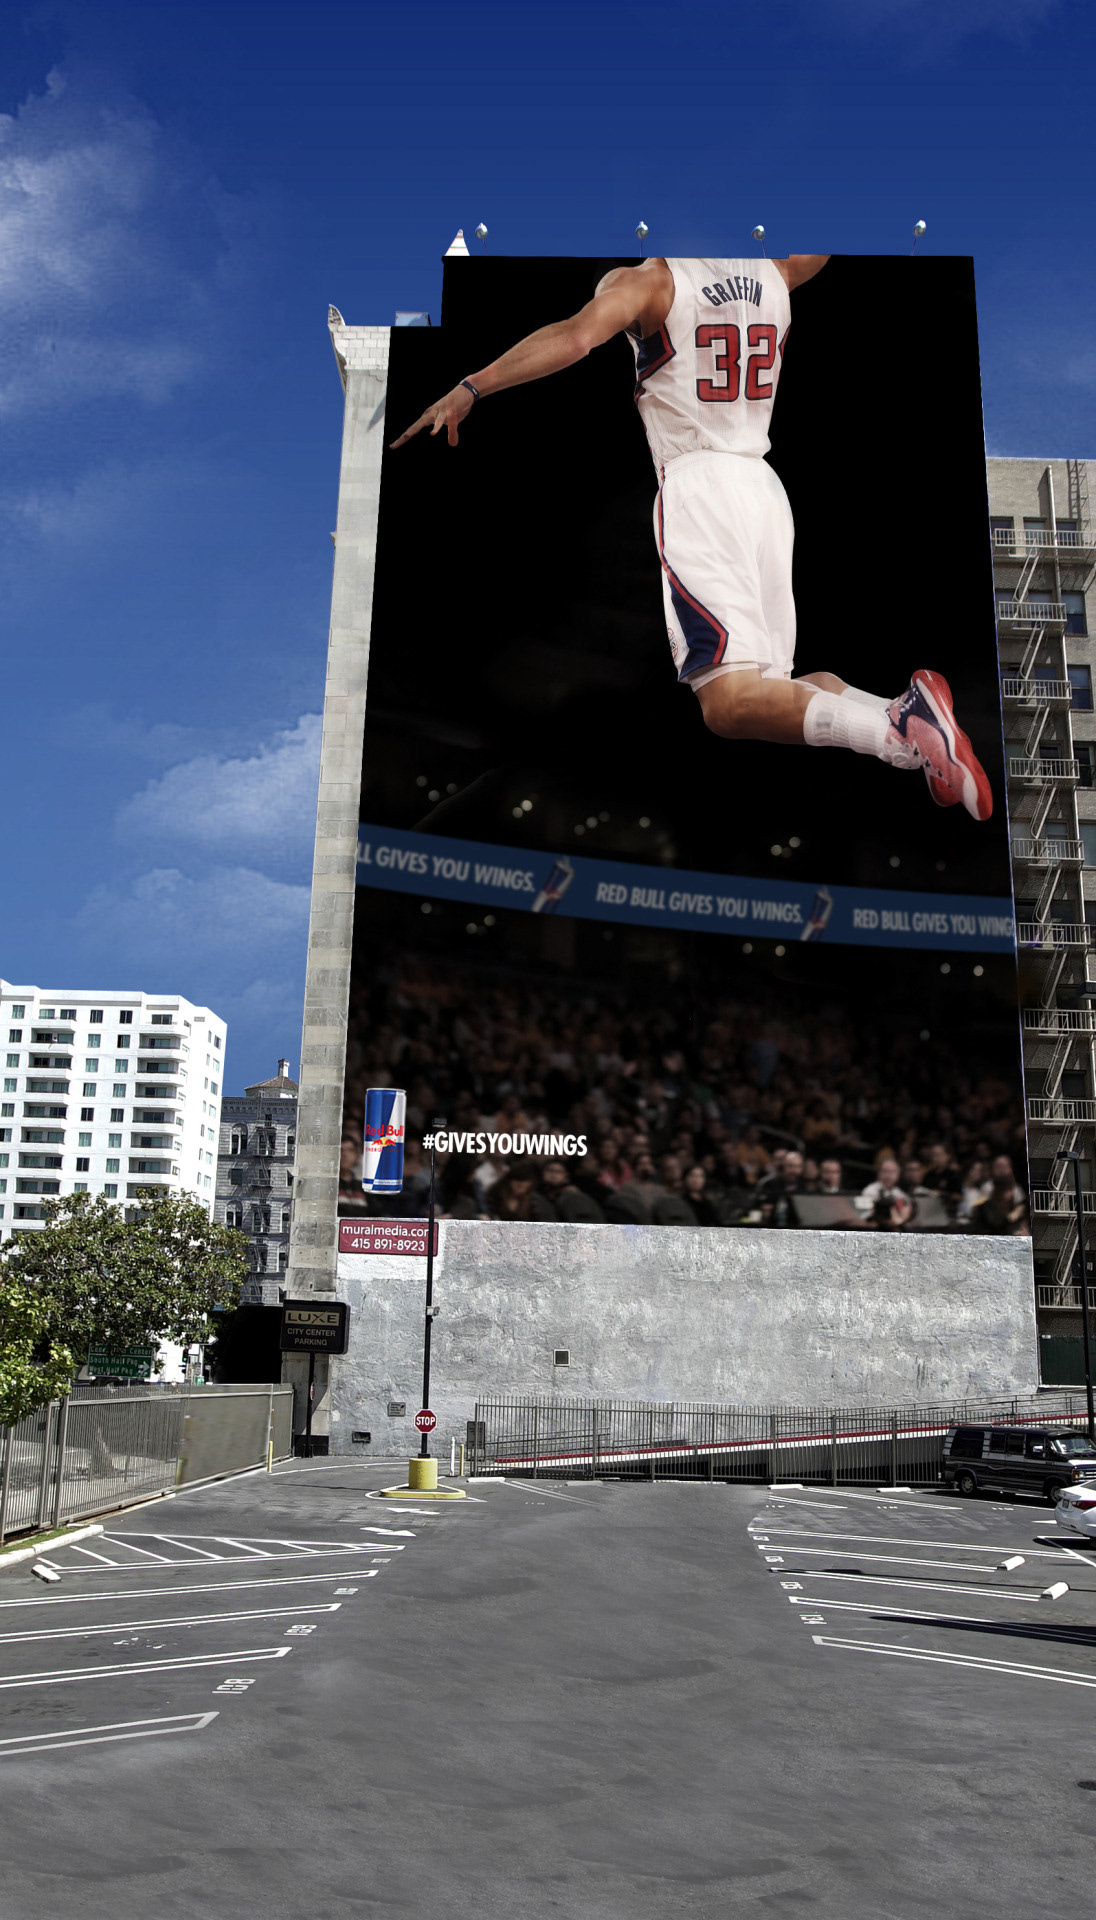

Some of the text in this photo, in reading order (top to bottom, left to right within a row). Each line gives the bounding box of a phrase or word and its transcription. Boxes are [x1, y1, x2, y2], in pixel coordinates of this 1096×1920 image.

[702, 276, 762, 307] GRIFFIN
[695, 324, 777, 402] 32
[375, 846, 428, 874] GIVES
[432, 856, 470, 881] YOU
[474, 863, 536, 892] WINGS.
[596, 881, 804, 923] RED BULL GIVES YOU WINGS.
[853, 908, 1015, 937] RED BULL GIVES YOU WING
[366, 1124, 404, 1137] Red Bull
[422, 1131, 588, 1157] #GIVESYOUWINGS
[351, 1238, 425, 1252] 415 891-8923
[287, 1311, 337, 1324] LUXE
[287, 1327, 336, 1337] CITY CENTER
[294, 1337, 328, 1346] PARKING
[129, 1347, 152, 1355] Center
[89, 1356, 110, 1364] South
[415, 1416, 436, 1426] STOP
